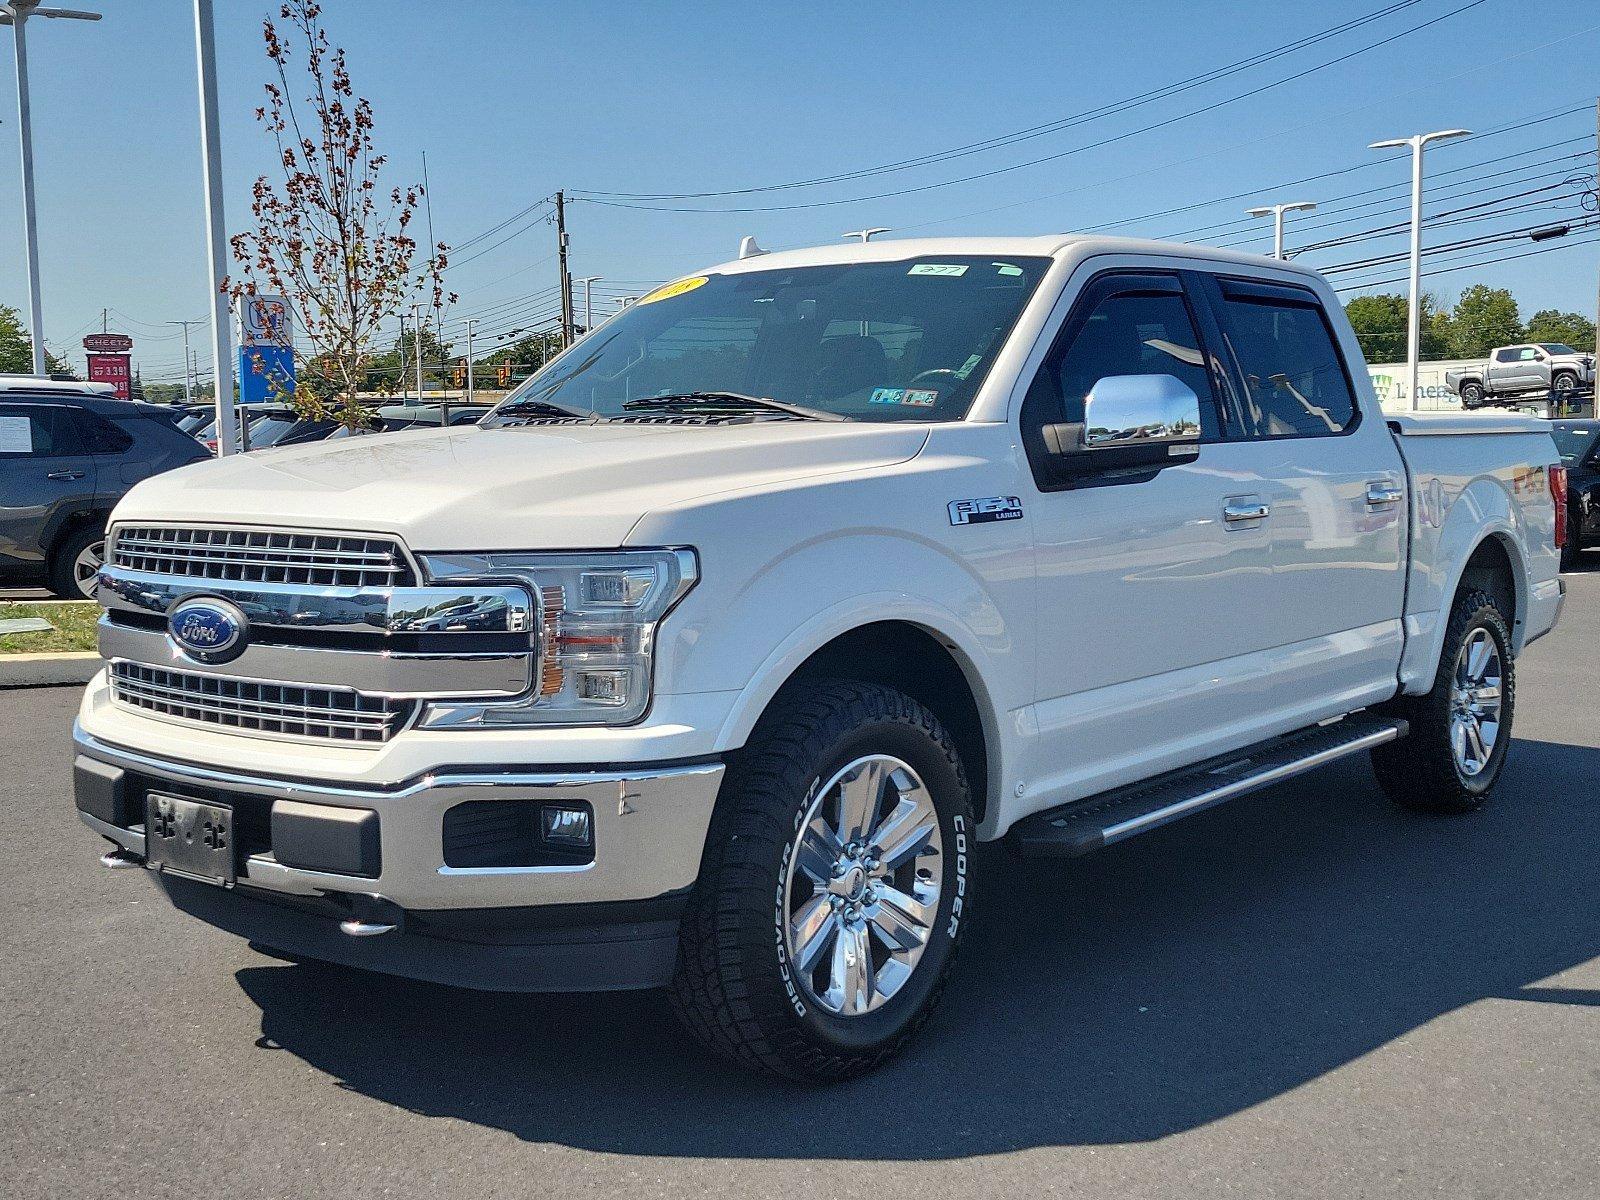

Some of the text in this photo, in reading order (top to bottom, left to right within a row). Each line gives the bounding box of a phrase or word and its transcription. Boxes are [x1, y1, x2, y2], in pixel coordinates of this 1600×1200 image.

[995, 511, 1022, 520] LARIAT
[181, 613, 220, 643] Ford
[947, 815, 967, 938] COOPER
[775, 842, 807, 1017] DISCOVERER
